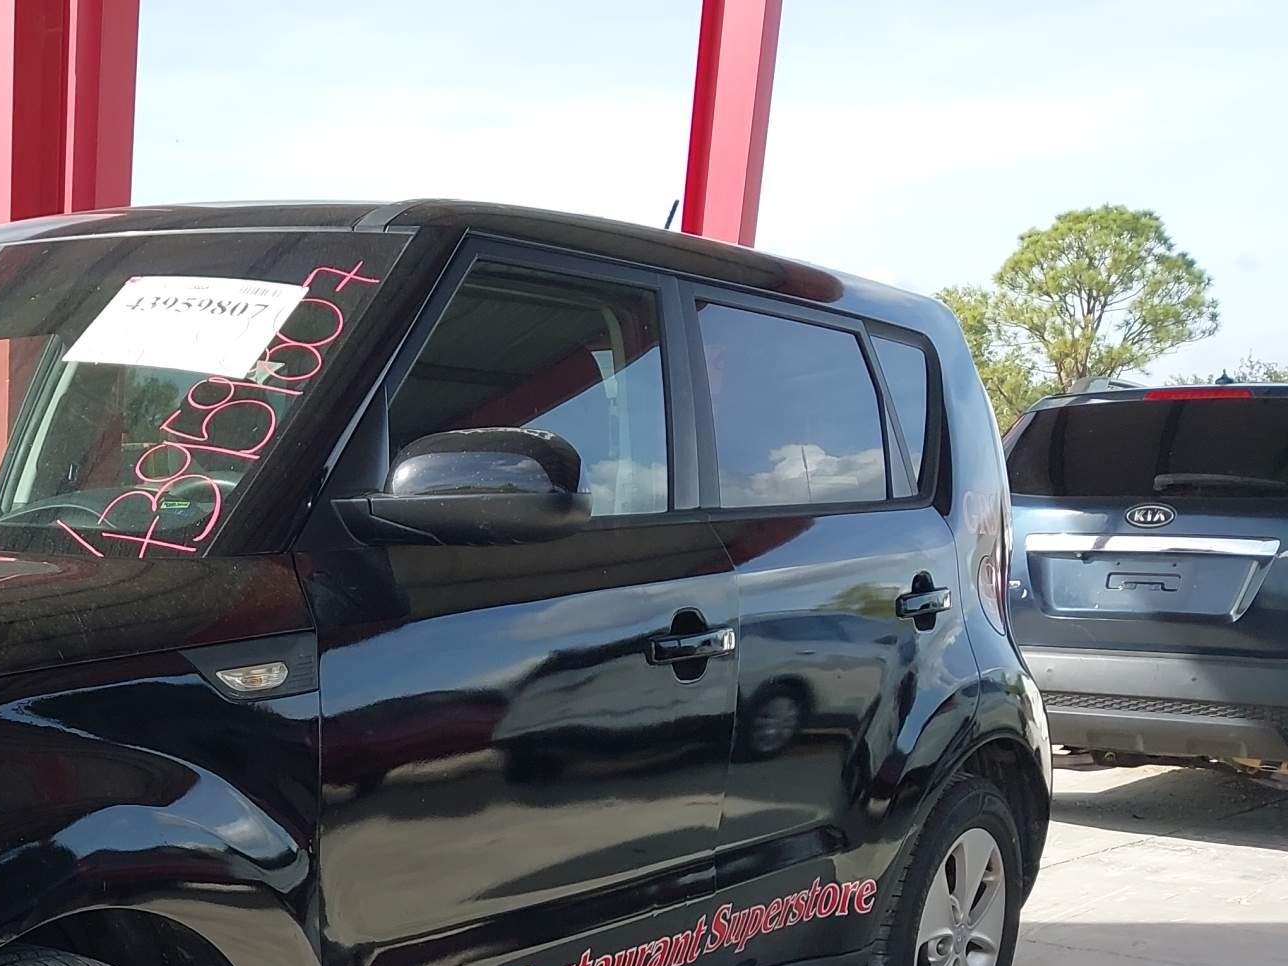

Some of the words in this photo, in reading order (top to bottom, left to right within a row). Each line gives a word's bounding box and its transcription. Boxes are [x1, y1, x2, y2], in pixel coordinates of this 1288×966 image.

[126, 295, 271, 320] 43959807
[1134, 510, 1166, 522] KIA
[702, 877, 878, 956] Superstore
